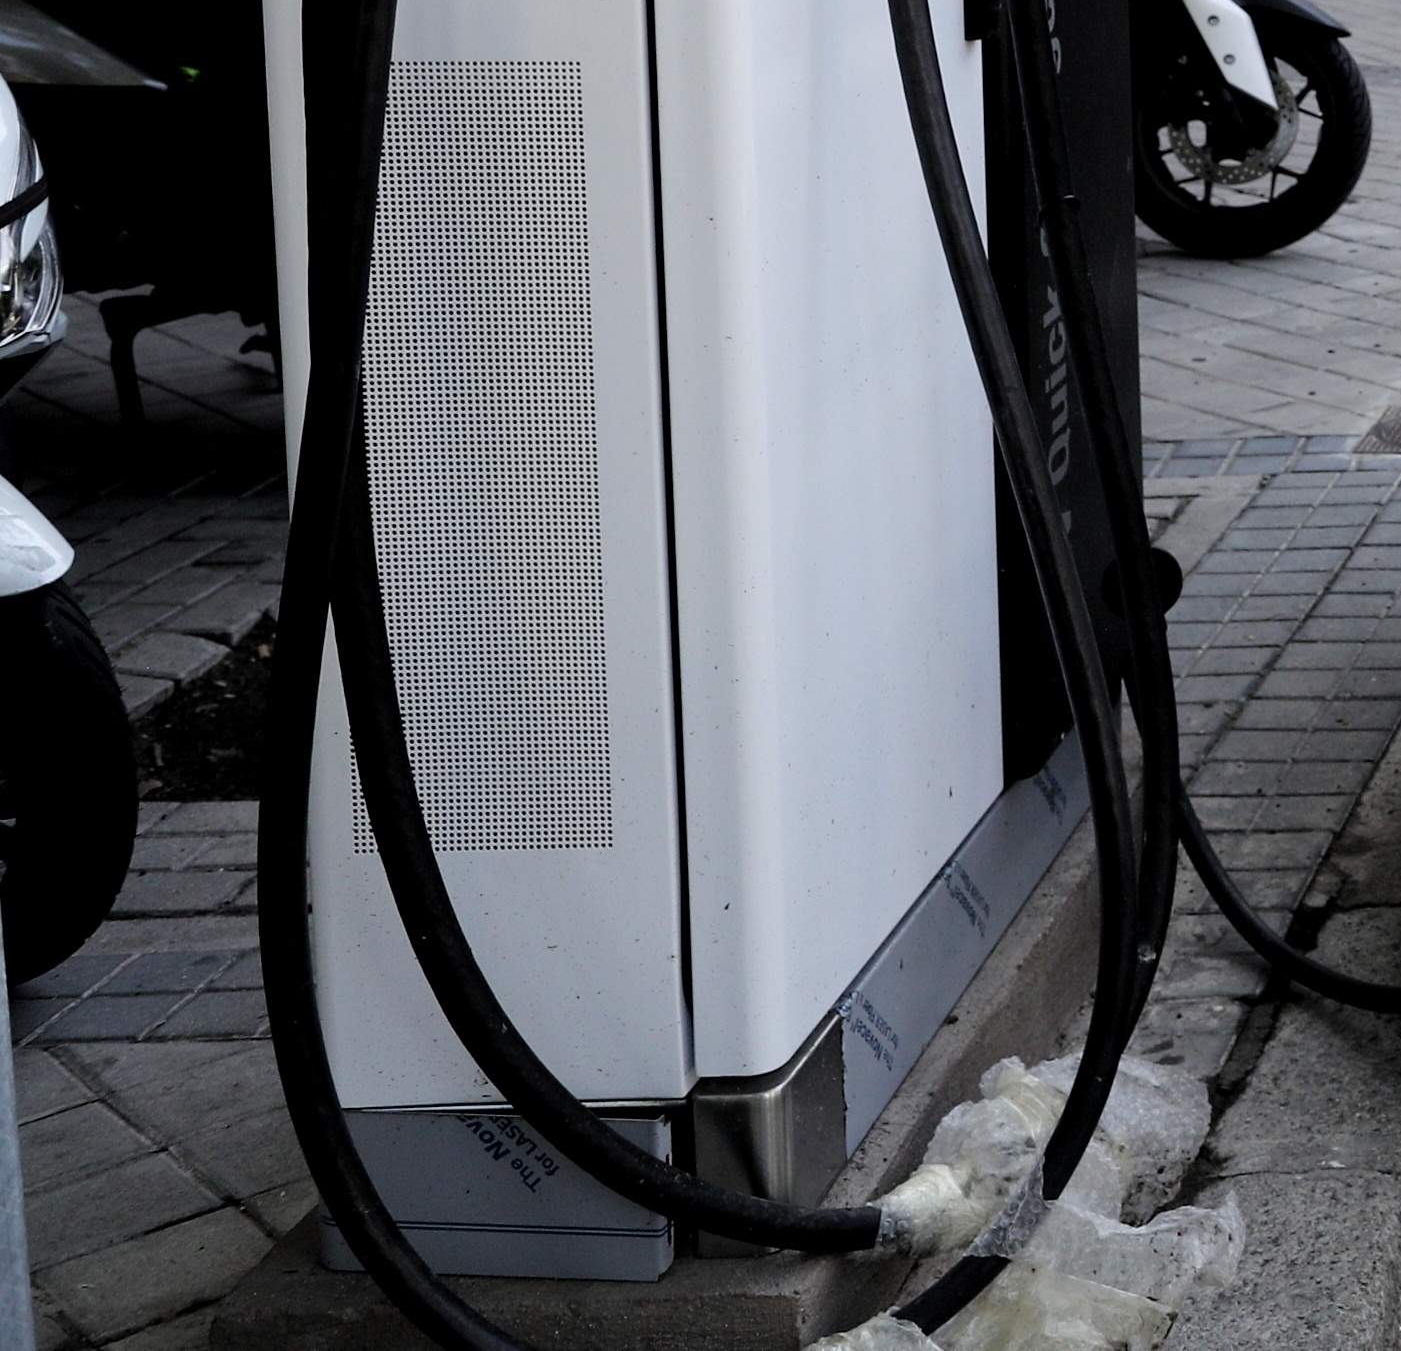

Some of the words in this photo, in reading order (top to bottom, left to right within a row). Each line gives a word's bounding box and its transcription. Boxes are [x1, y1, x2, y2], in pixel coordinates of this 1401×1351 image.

[1042, 285, 1071, 487] Quick
[510, 1156, 541, 1193] The
[534, 1152, 560, 1177] for
